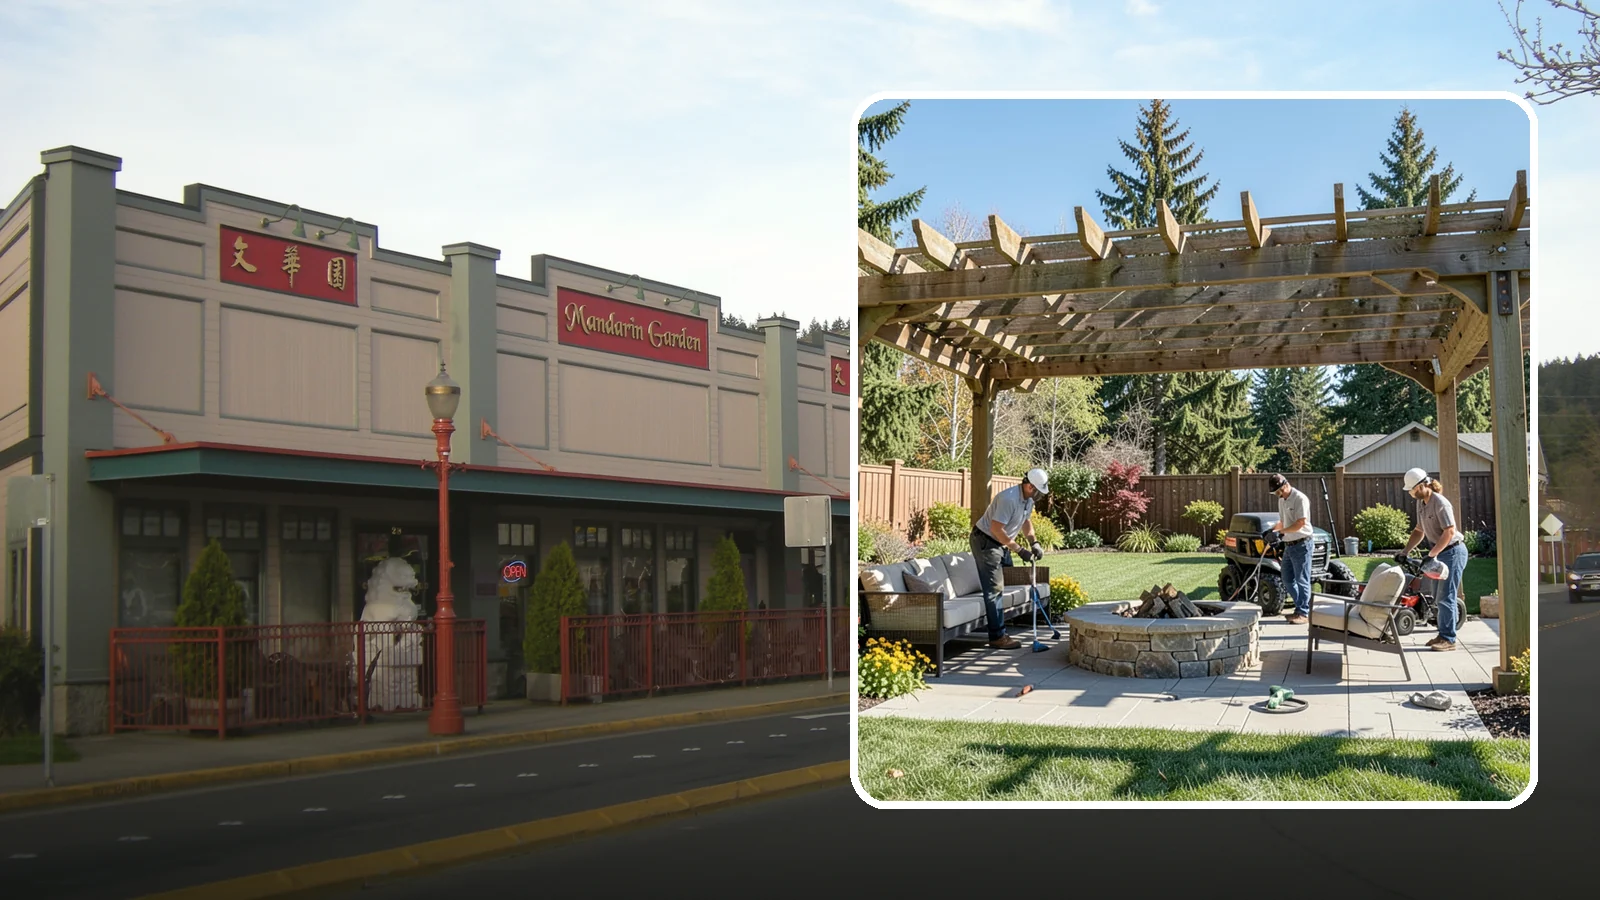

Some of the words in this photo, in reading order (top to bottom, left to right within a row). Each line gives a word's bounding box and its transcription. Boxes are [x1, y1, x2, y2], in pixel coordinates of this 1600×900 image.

[231, 236, 346, 290] 文華園
[565, 302, 643, 340] Mandarin
[648, 320, 700, 351] Garden
[503, 565, 527, 578] OPEN
